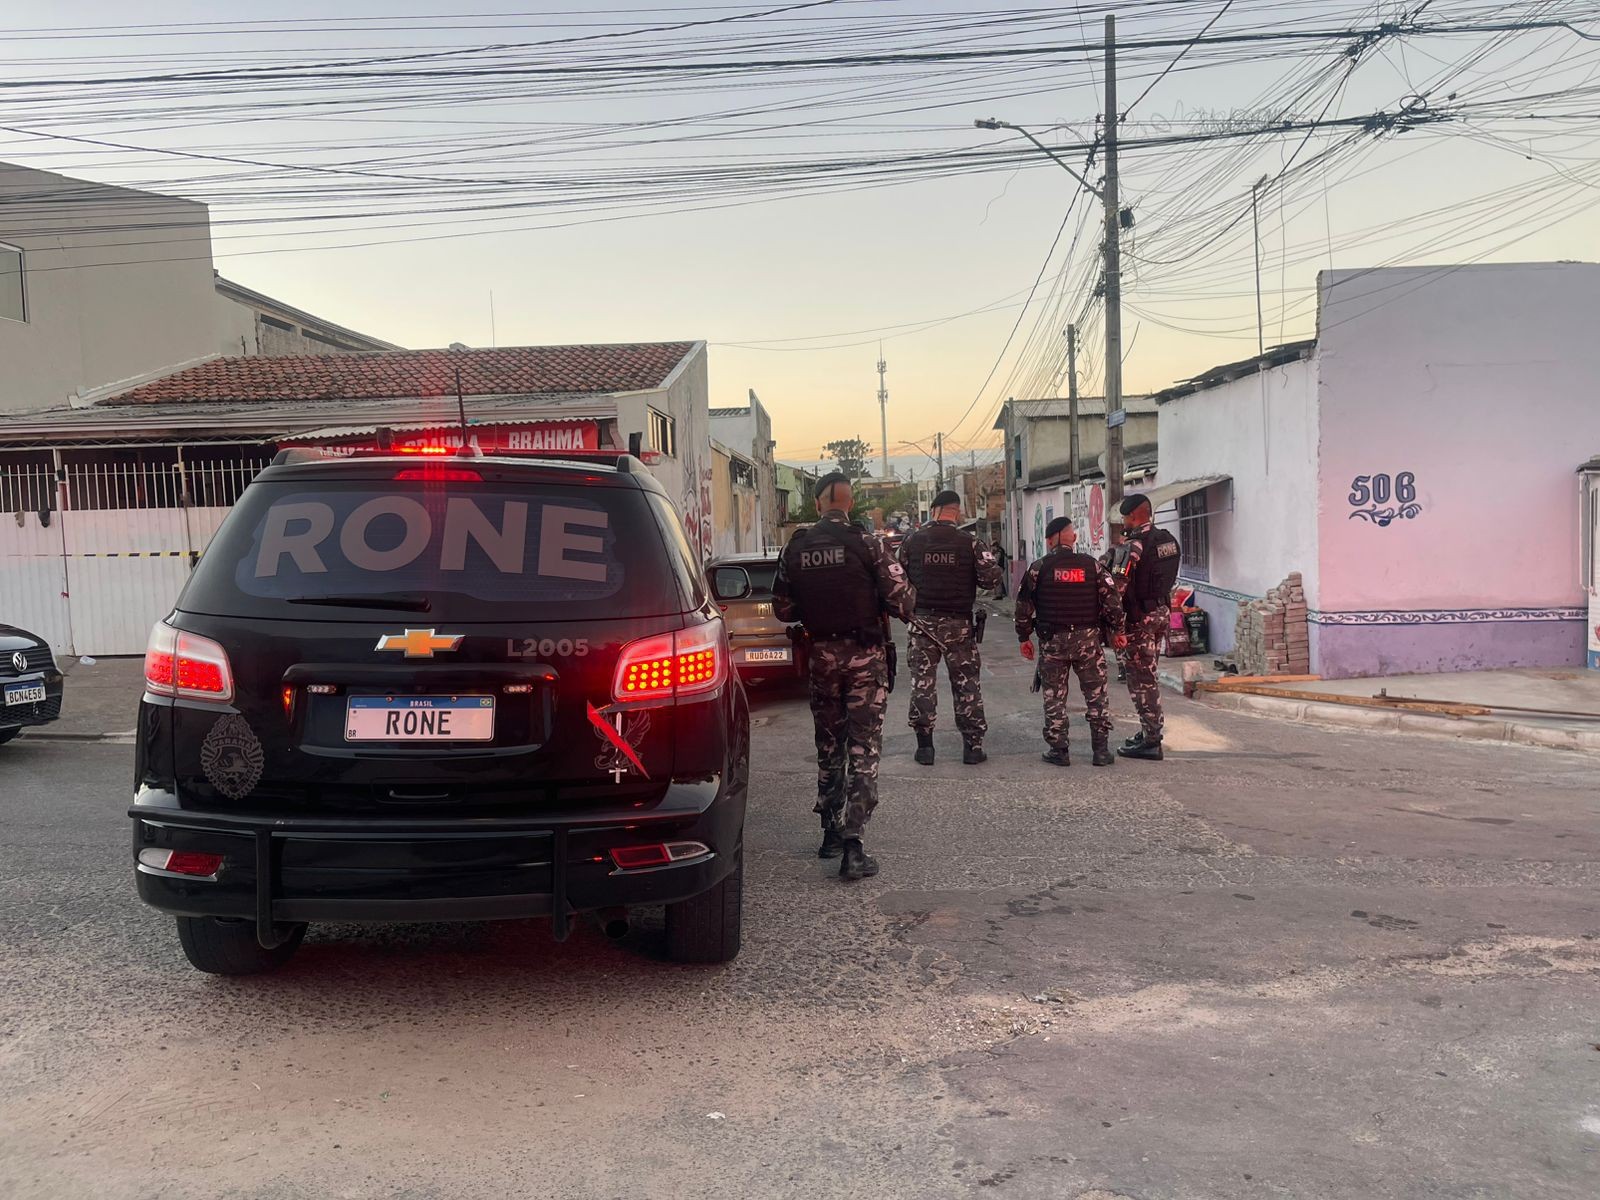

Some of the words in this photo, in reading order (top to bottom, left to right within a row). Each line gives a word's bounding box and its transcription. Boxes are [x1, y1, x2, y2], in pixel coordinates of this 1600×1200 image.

[508, 428, 585, 450] BRAHMA
[1348, 471, 1416, 507] 506
[255, 496, 609, 582] RONE
[801, 549, 845, 567] RONE
[924, 552, 956, 564] RONE
[1054, 570, 1086, 582] RONE
[507, 638, 589, 657] L2005
[9, 688, 42, 703] BCN4E58
[386, 710, 452, 735] RONE
[348, 729, 357, 738] BR
